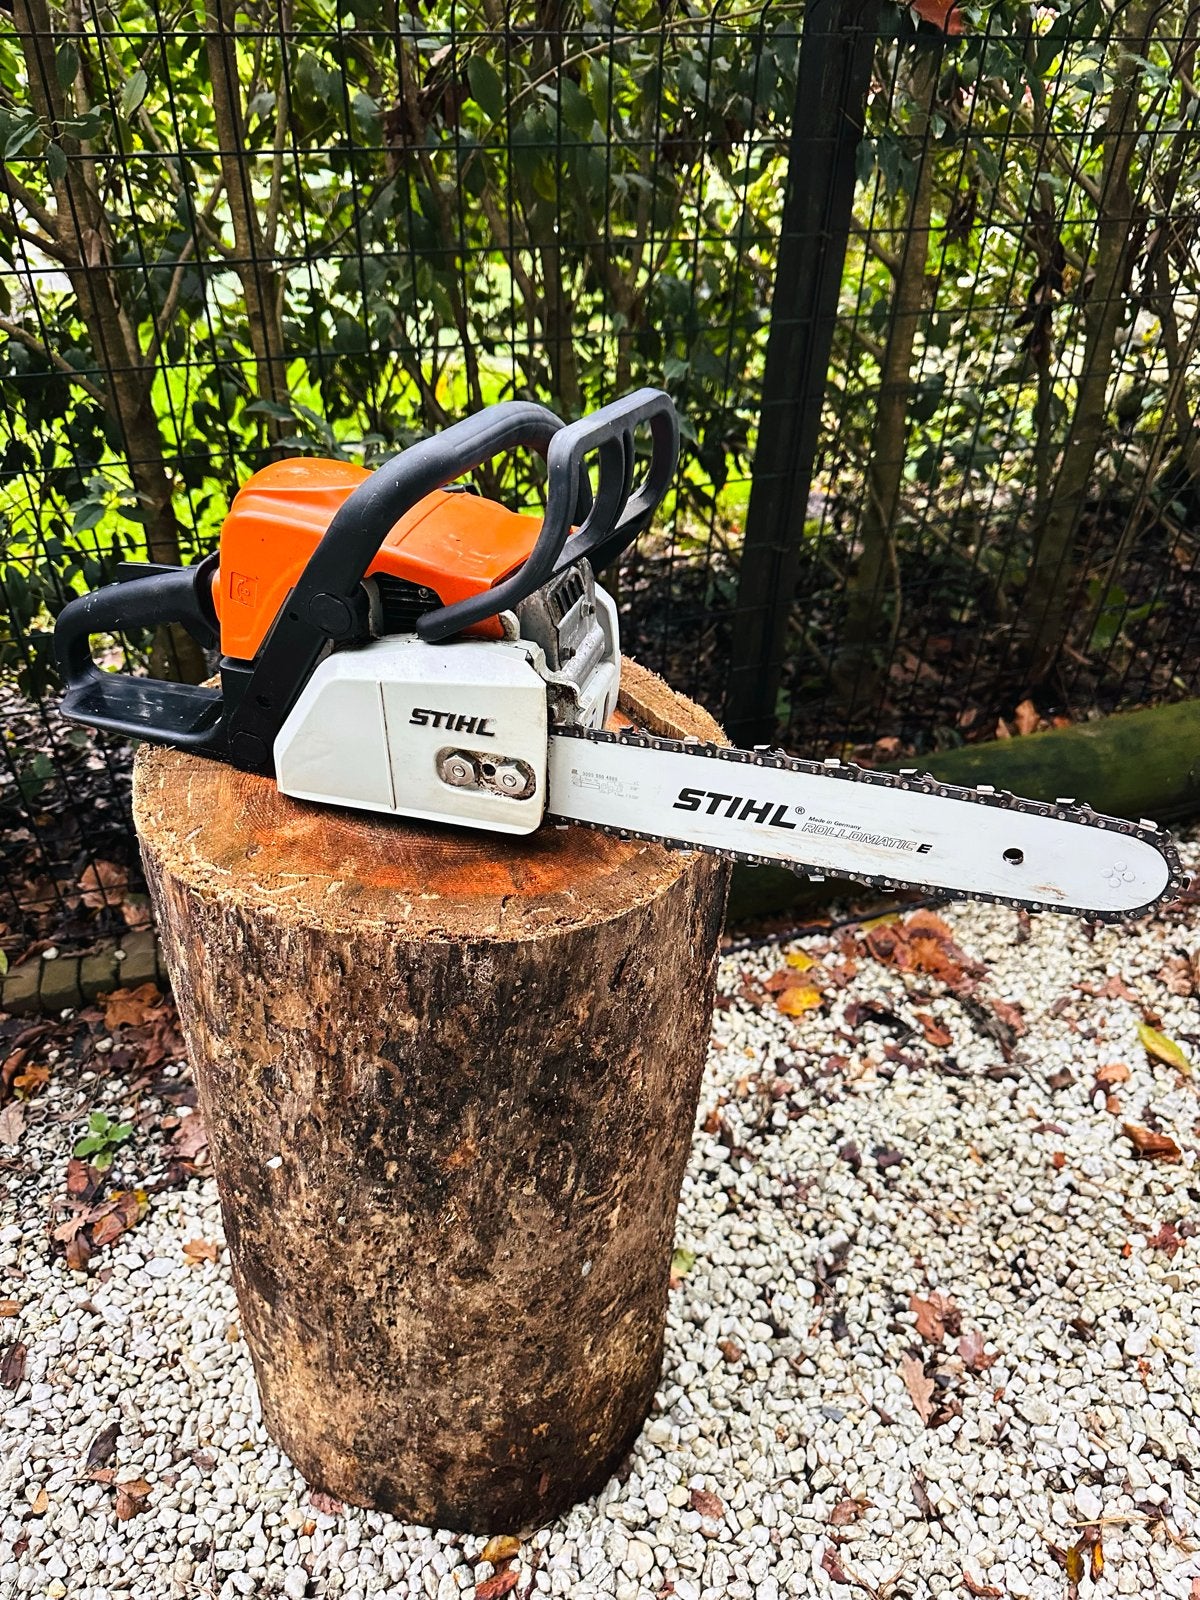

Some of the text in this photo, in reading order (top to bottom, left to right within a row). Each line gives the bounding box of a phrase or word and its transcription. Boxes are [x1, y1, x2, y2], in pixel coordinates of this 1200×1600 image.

[808, 816, 825, 824] Made
[834, 820, 861, 830] Germany
[801, 822, 933, 854] ROLLOMATIC E
